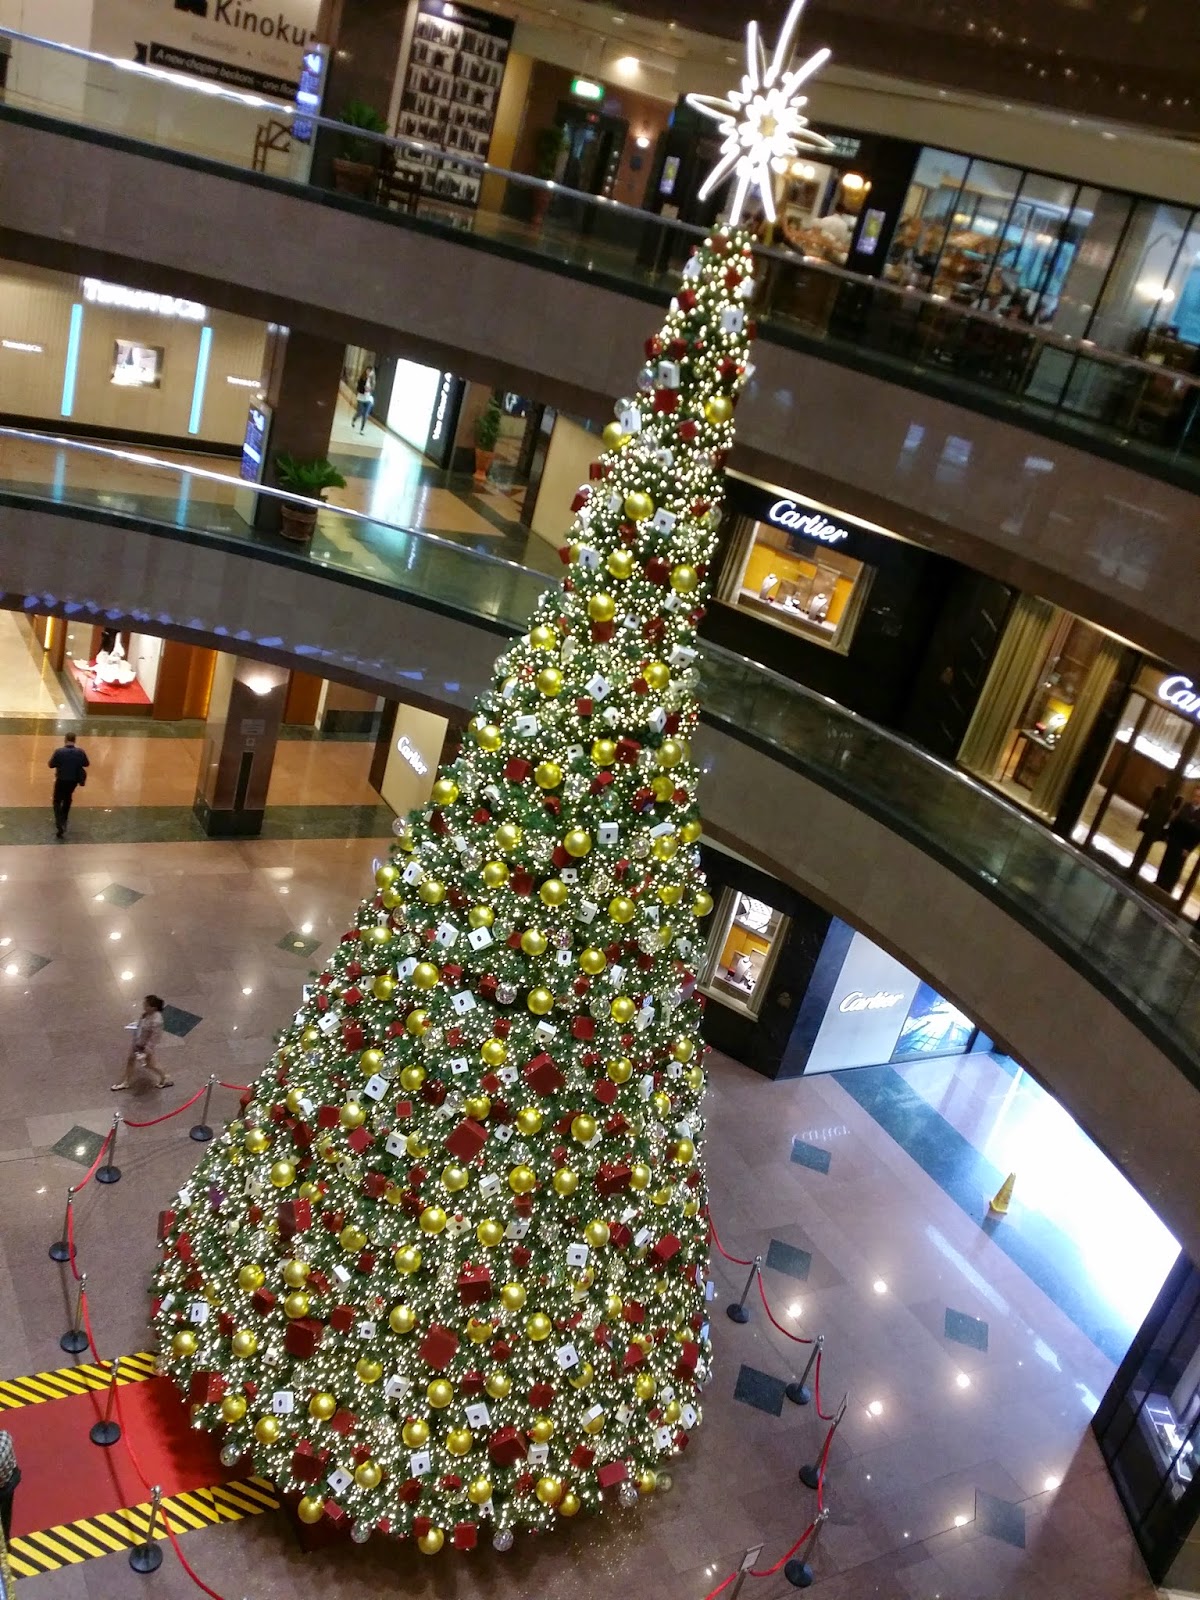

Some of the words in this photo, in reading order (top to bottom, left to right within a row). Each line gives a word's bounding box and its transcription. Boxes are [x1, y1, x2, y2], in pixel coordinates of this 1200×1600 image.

[769, 500, 848, 543] Cartier
[397, 736, 428, 775] Cartier
[839, 991, 905, 1013] Cartier
